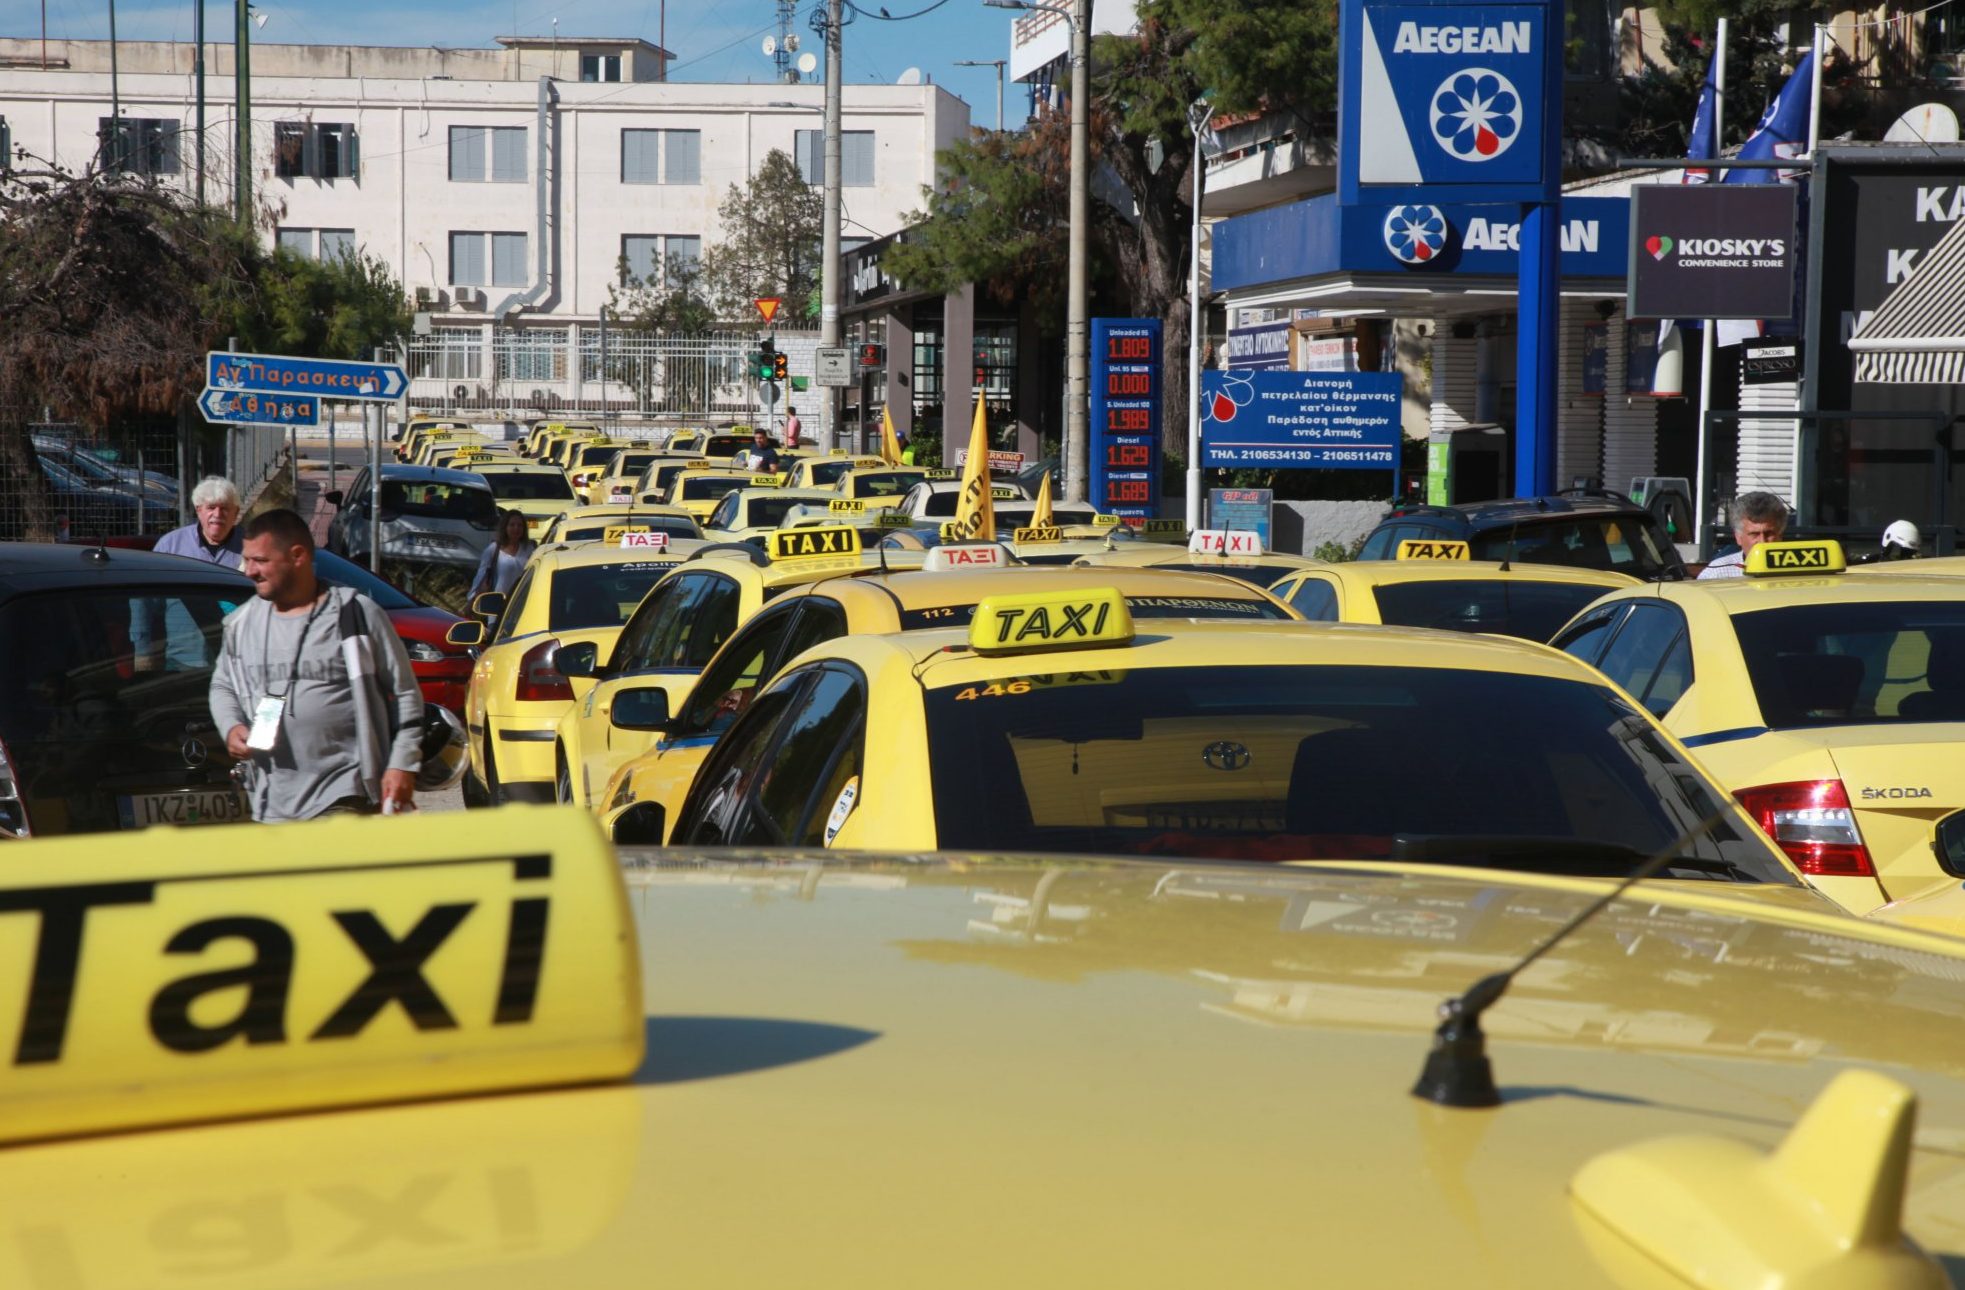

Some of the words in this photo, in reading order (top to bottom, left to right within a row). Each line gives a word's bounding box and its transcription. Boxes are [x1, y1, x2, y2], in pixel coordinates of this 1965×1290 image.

[1393, 21, 1531, 54] AEGEAN
[1678, 239, 1785, 257] KIOSKY'S
[1678, 259, 1749, 268] CONVENIENCE
[1752, 259, 1784, 268] STORE
[1108, 338, 1150, 358] 1.809
[1108, 374, 1150, 394] 0.000
[1304, 379, 1353, 390] Διανομή
[1261, 391, 1328, 402] πετρελαίου
[1332, 391, 1396, 403] θέρμανσης
[1108, 410, 1150, 430] 1.989
[1267, 415, 1329, 426] Παράδοση
[1332, 415, 1389, 426] αυθημερόν
[1292, 428, 1321, 439] εντός
[1323, 428, 1362, 439] Αττικής
[988, 452, 1020, 461] RKING
[1108, 445, 1149, 466] 1.629
[1210, 450, 1238, 459] ΤΗΛ.
[1241, 450, 1312, 460] 2106534130
[1322, 451, 1392, 461] 2106511478
[1108, 481, 1149, 501] 1.689
[835, 501, 862, 510] TAXI
[783, 532, 848, 554] TAXI
[1019, 529, 1057, 541] TAXI
[1202, 535, 1252, 551] TAXI
[1406, 543, 1465, 560] TAXI
[1769, 549, 1826, 567] TAXI
[622, 562, 681, 571] Apollo
[922, 608, 955, 619] 112
[996, 602, 1110, 642] TAXI
[955, 681, 1032, 701] 446
[1861, 787, 1933, 800] ŠKODA
[0, 853, 554, 1067] Taxi
